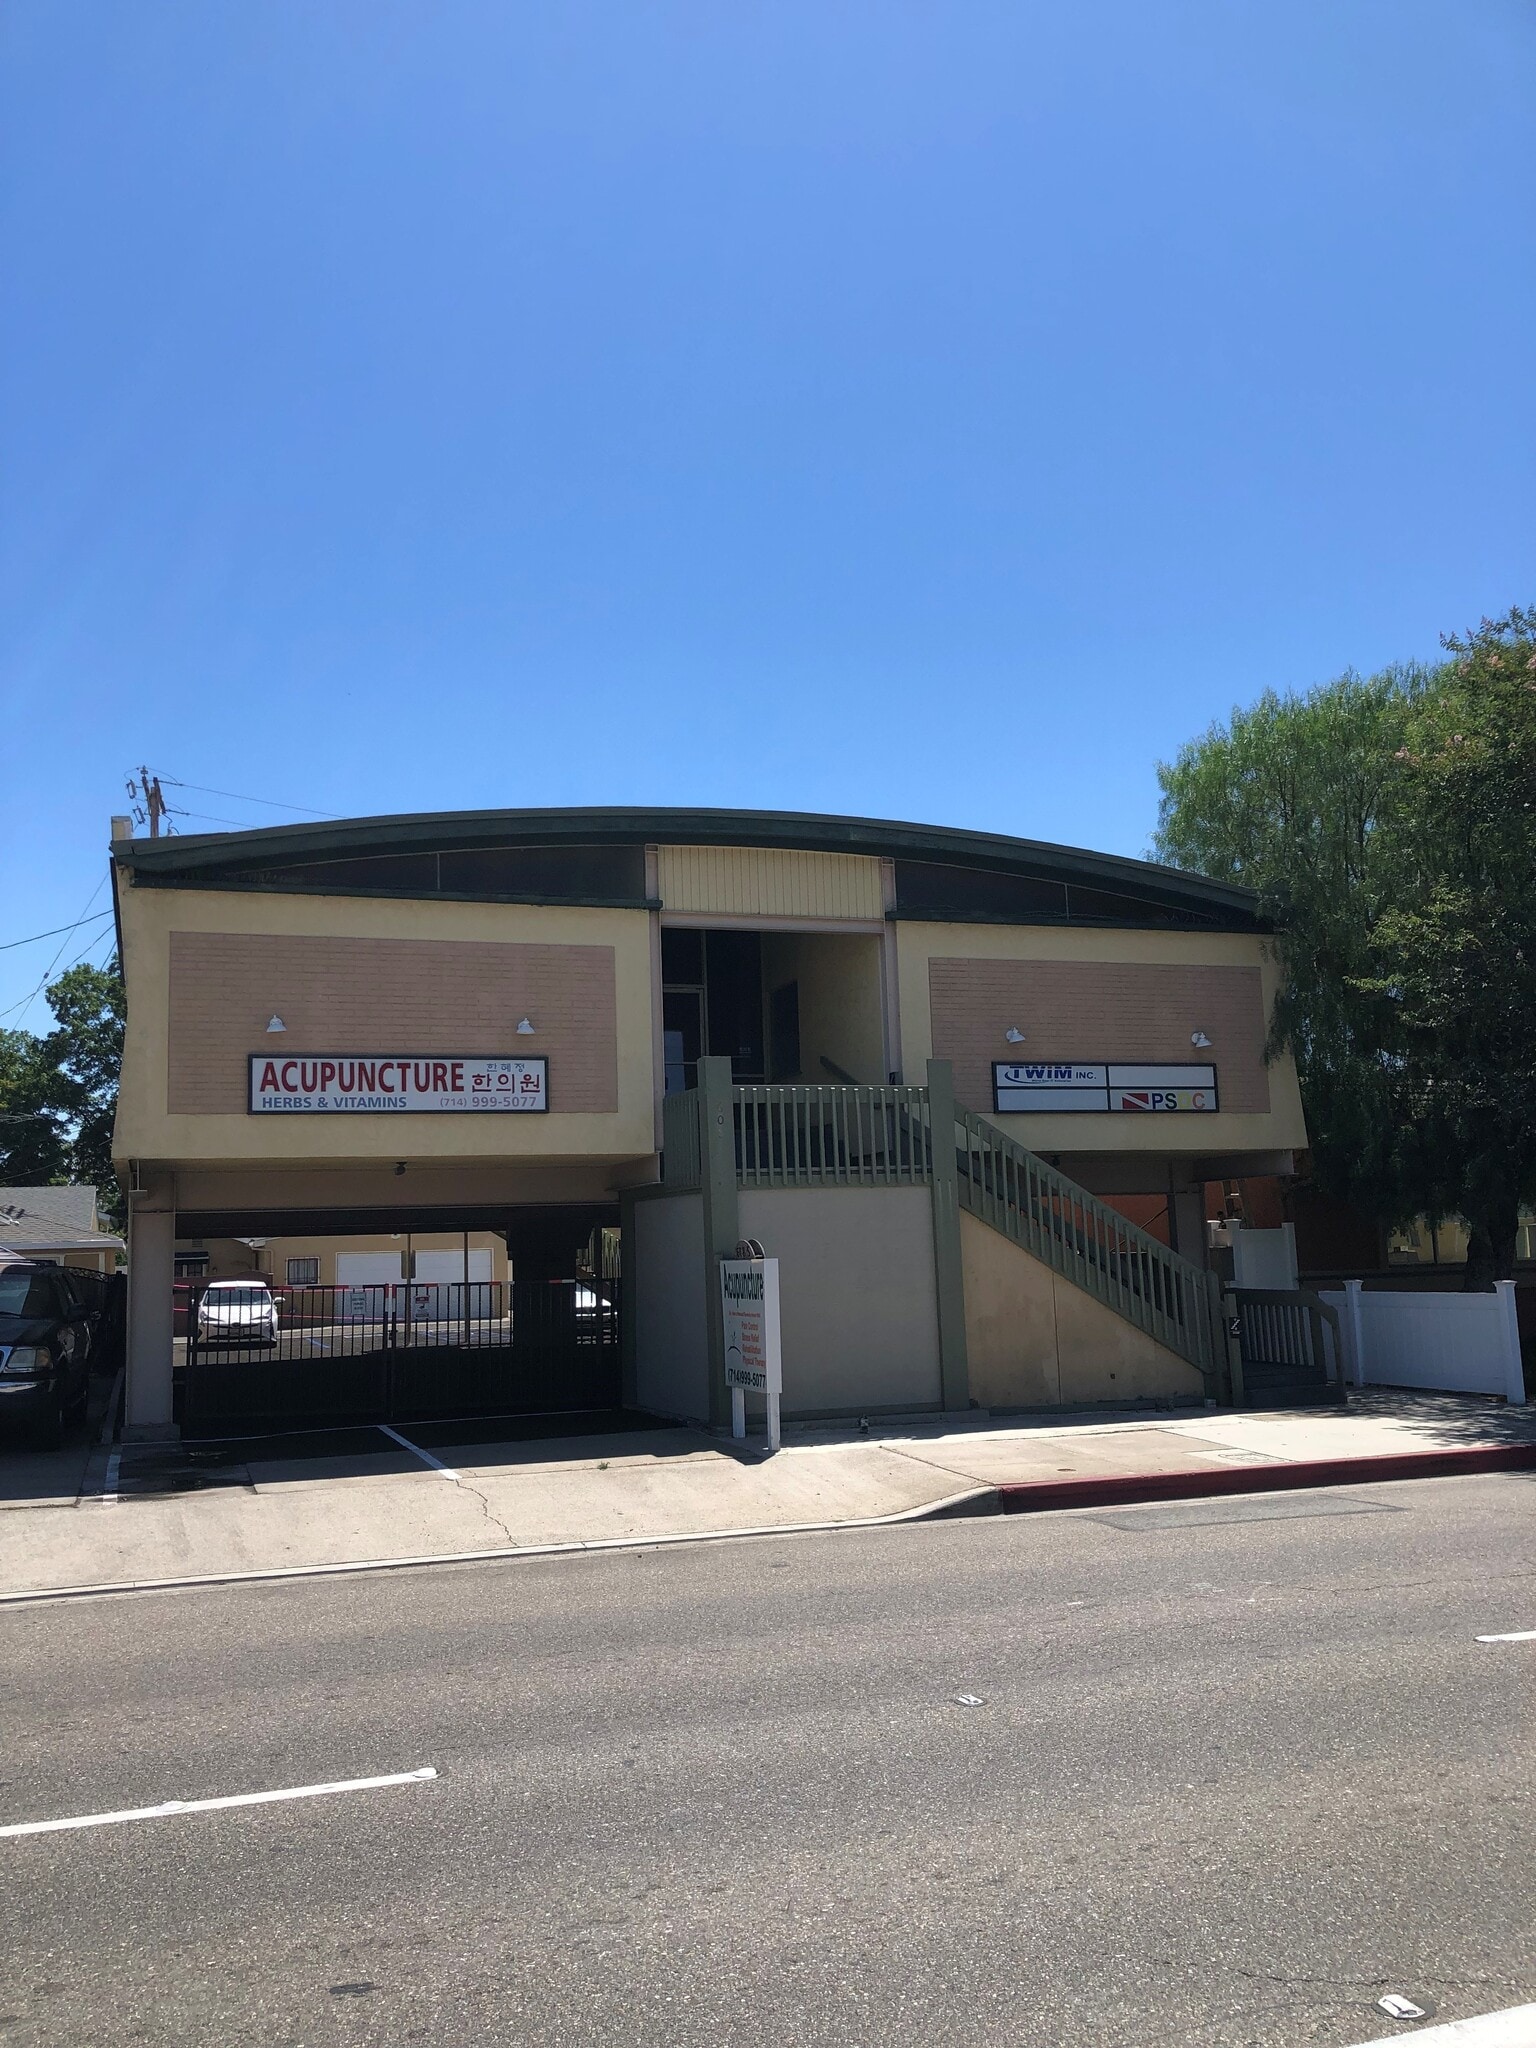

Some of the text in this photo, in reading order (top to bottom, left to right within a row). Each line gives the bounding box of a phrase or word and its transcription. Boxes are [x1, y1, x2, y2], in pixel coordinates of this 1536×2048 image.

[260, 1061, 464, 1093] ACUPUNCTURE
[1076, 1071, 1097, 1079] INC.
[472, 1073, 541, 1094] 한의원
[262, 1096, 407, 1108] HERBS & VITAMINS
[440, 1096, 537, 1107] (714) 999-5077
[724, 1264, 764, 1308] Acupuncture
